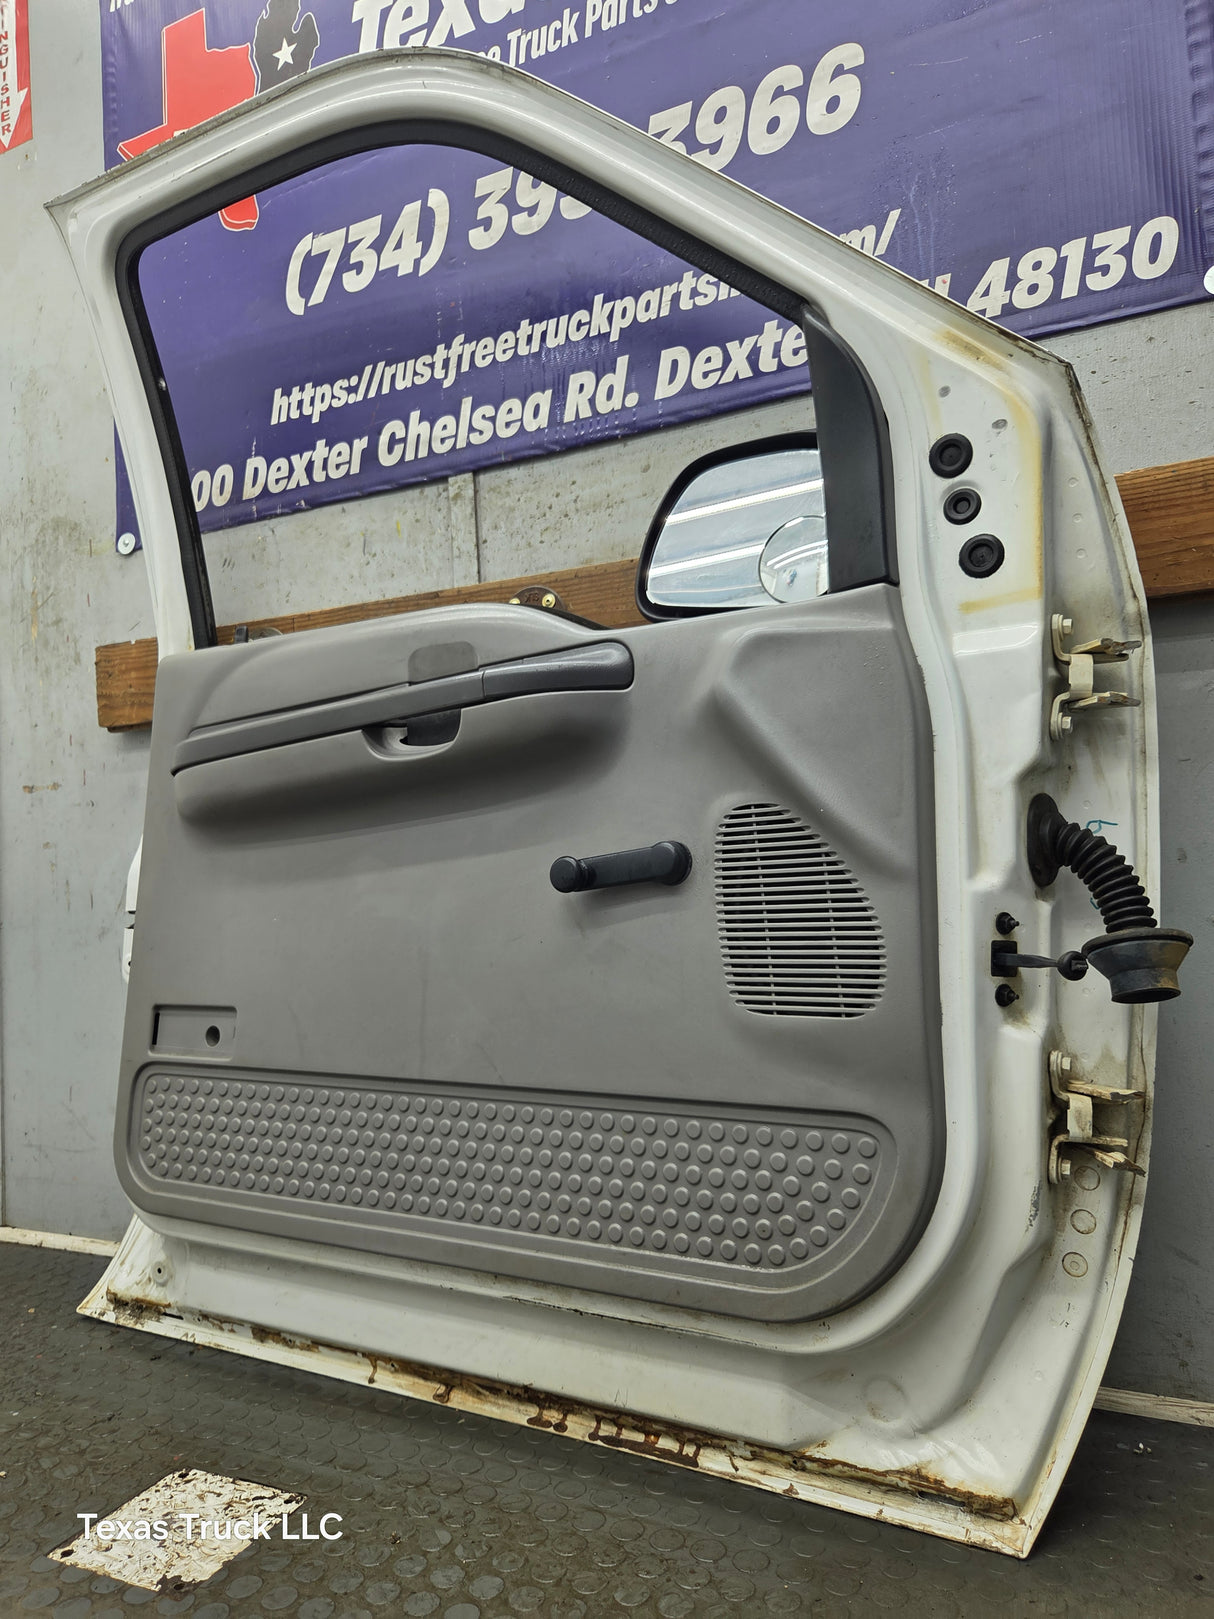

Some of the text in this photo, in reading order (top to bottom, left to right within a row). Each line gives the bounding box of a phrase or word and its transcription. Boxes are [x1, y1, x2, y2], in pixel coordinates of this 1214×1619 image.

[507, 7, 580, 67] Truck
[285, 188, 450, 316] (734)
[648, 42, 865, 172] 3966
[242, 435, 369, 501] Dexter
[378, 389, 553, 467] Chelsea
[563, 354, 639, 424] Rd.
[966, 215, 1180, 319] 48130
